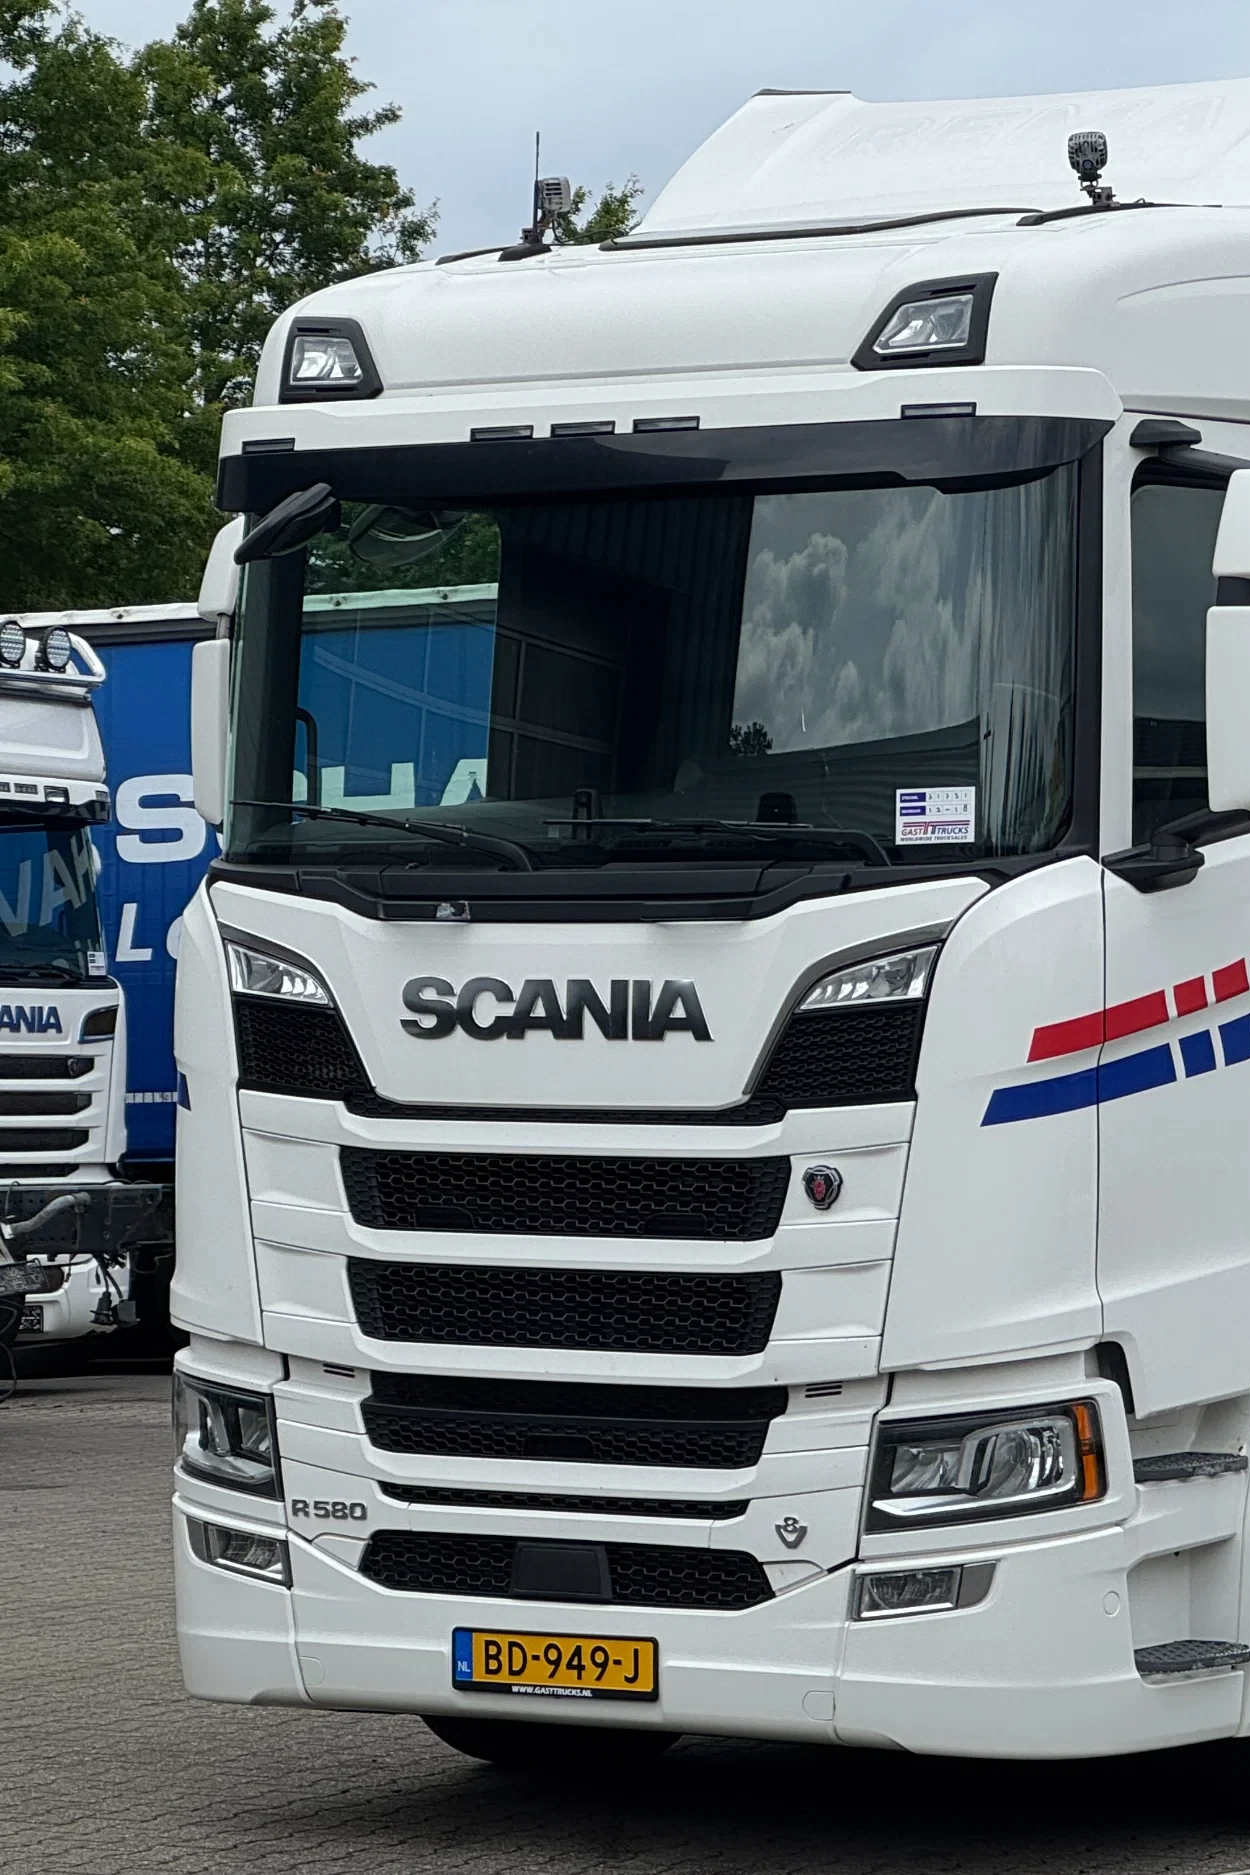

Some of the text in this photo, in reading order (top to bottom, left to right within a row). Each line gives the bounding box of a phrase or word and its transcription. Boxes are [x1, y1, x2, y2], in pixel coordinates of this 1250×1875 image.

[399, 976, 715, 1041] SCANIA
[291, 1499, 367, 1522] R 580
[457, 1660, 471, 1673] NL
[484, 1639, 640, 1685] BD-949-J
[511, 1684, 593, 1698] WWW.GASTTRUCKS.NL
